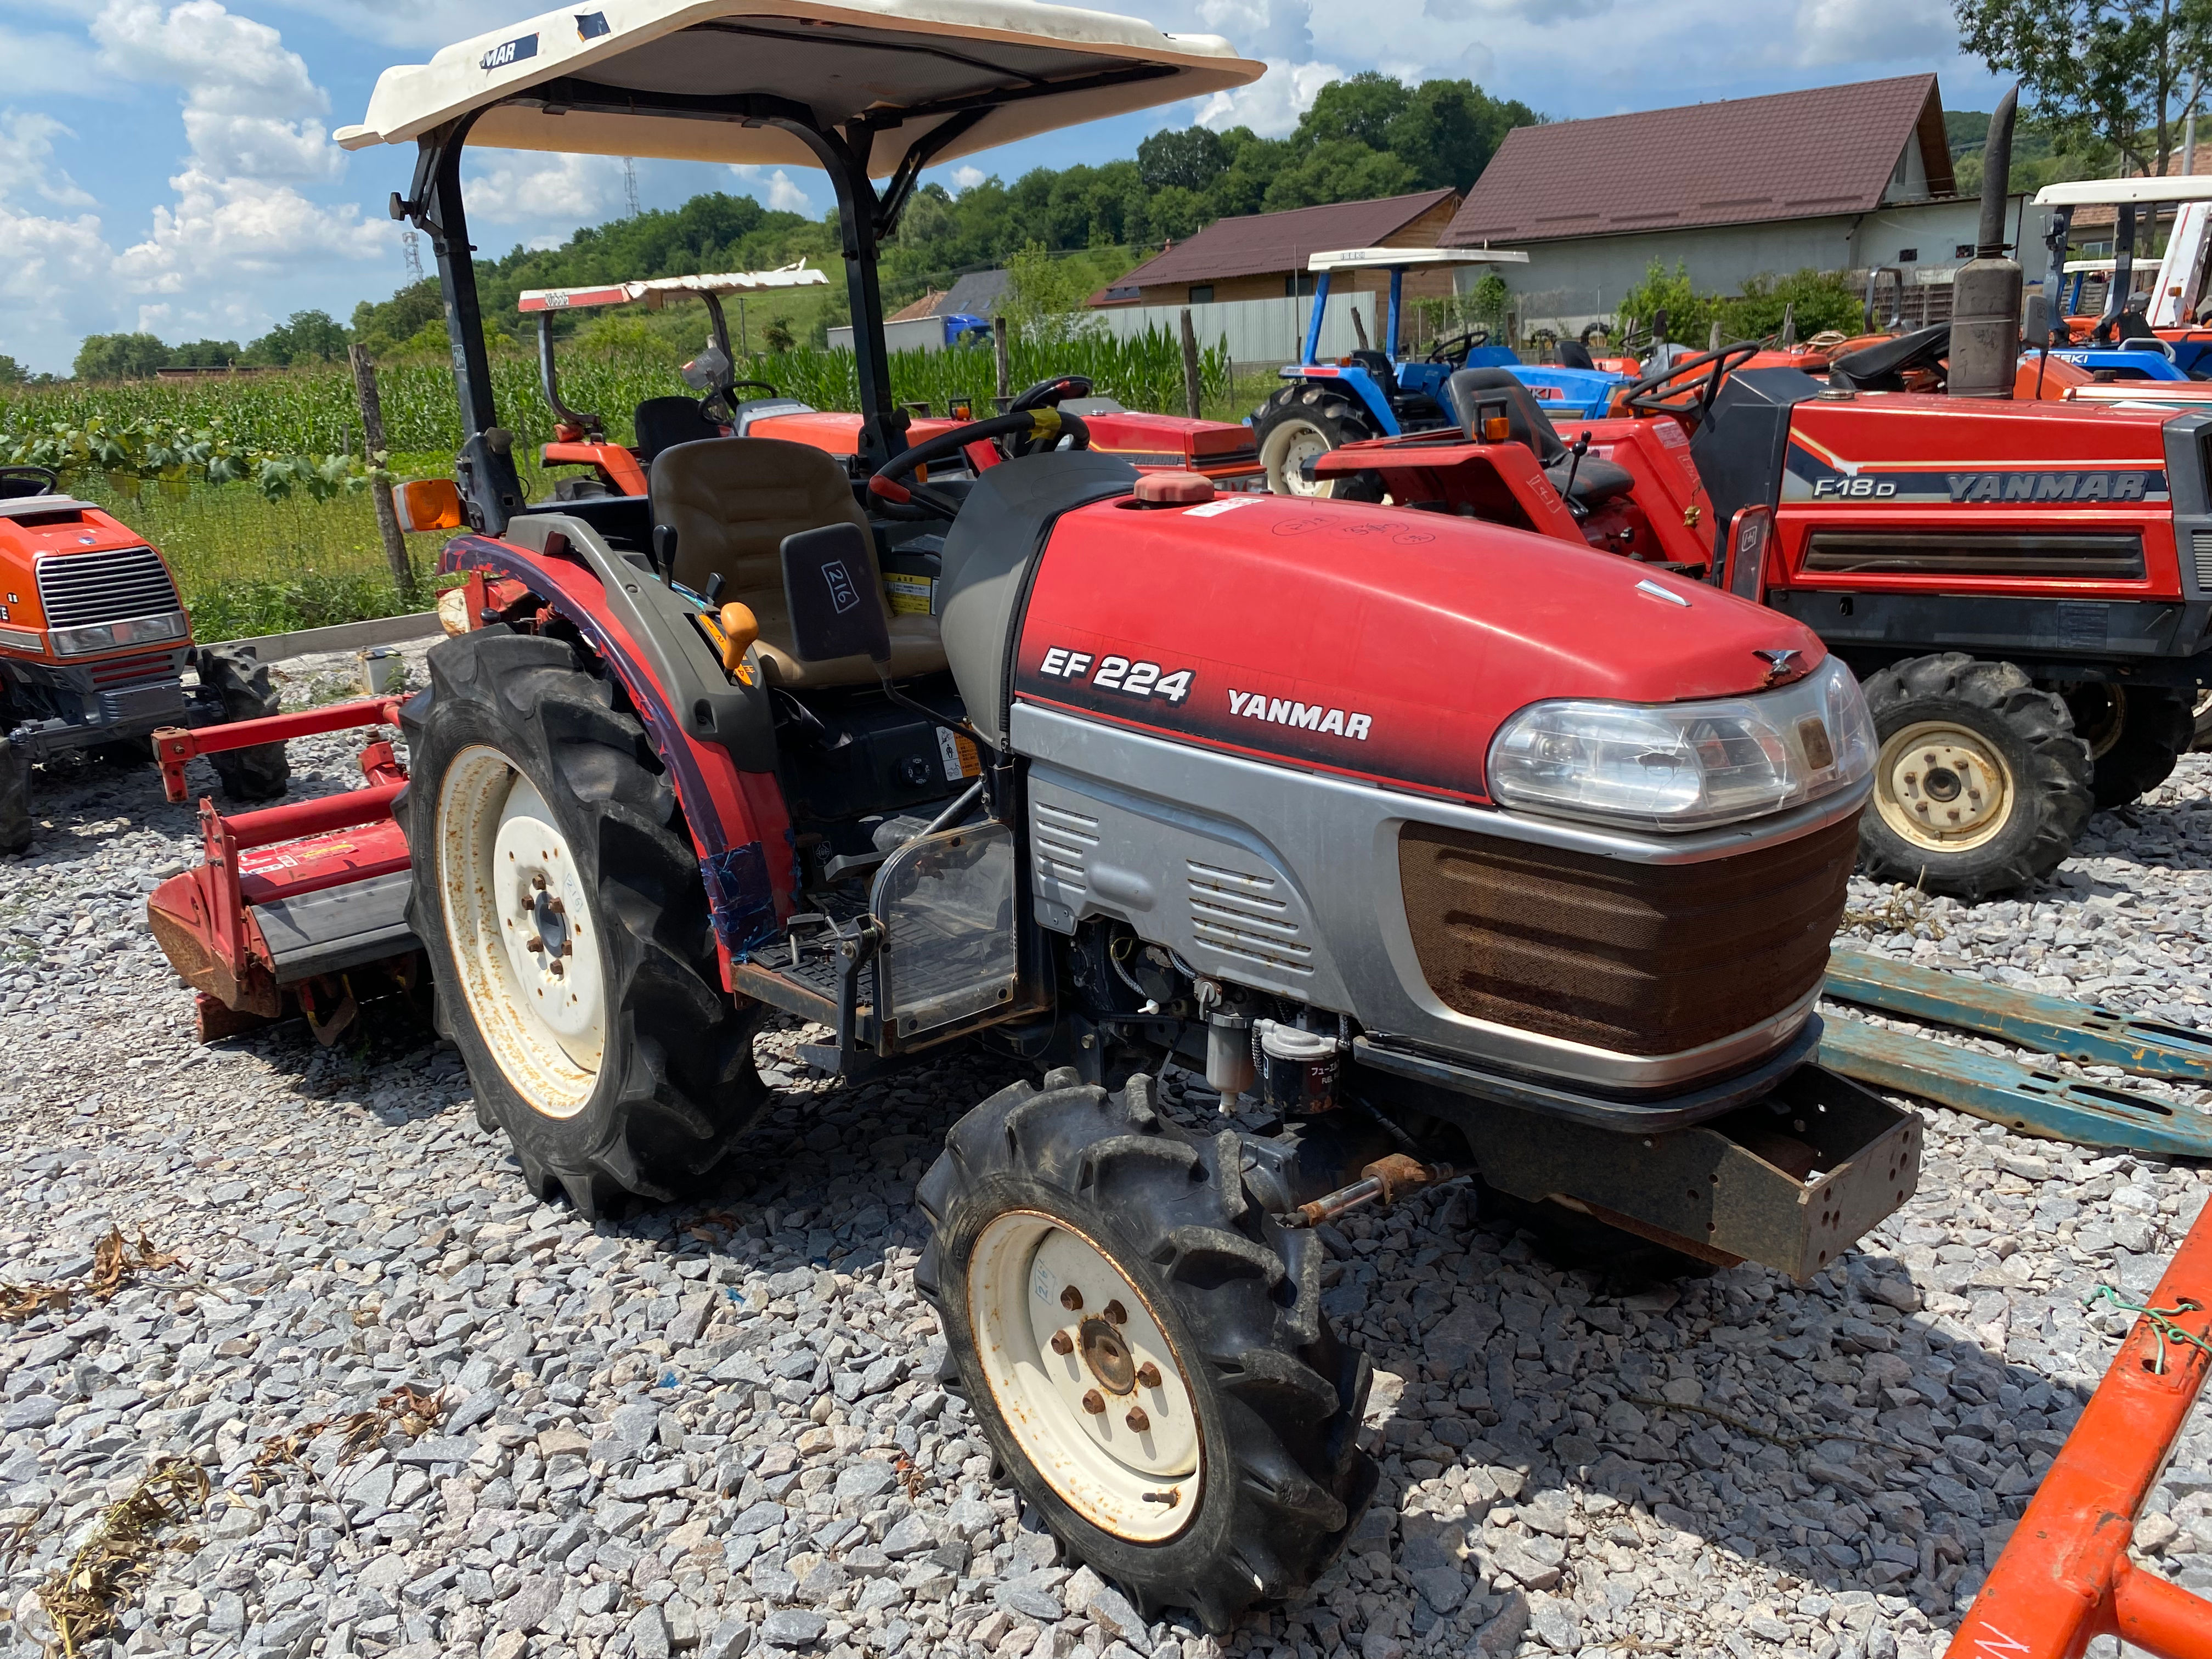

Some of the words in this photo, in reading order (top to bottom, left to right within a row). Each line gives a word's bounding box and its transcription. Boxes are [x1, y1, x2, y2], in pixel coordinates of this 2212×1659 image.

[545, 291, 569, 307] Kubota
[1947, 474, 2147, 500] YANMAR
[828, 569, 851, 603] 216
[1040, 647, 1092, 678] EF
[1093, 656, 1192, 702] 224
[1228, 689, 1373, 741] YANMAR
[1322, 1076, 1333, 1084] FUEL
[1037, 1269, 1048, 1299] 216
